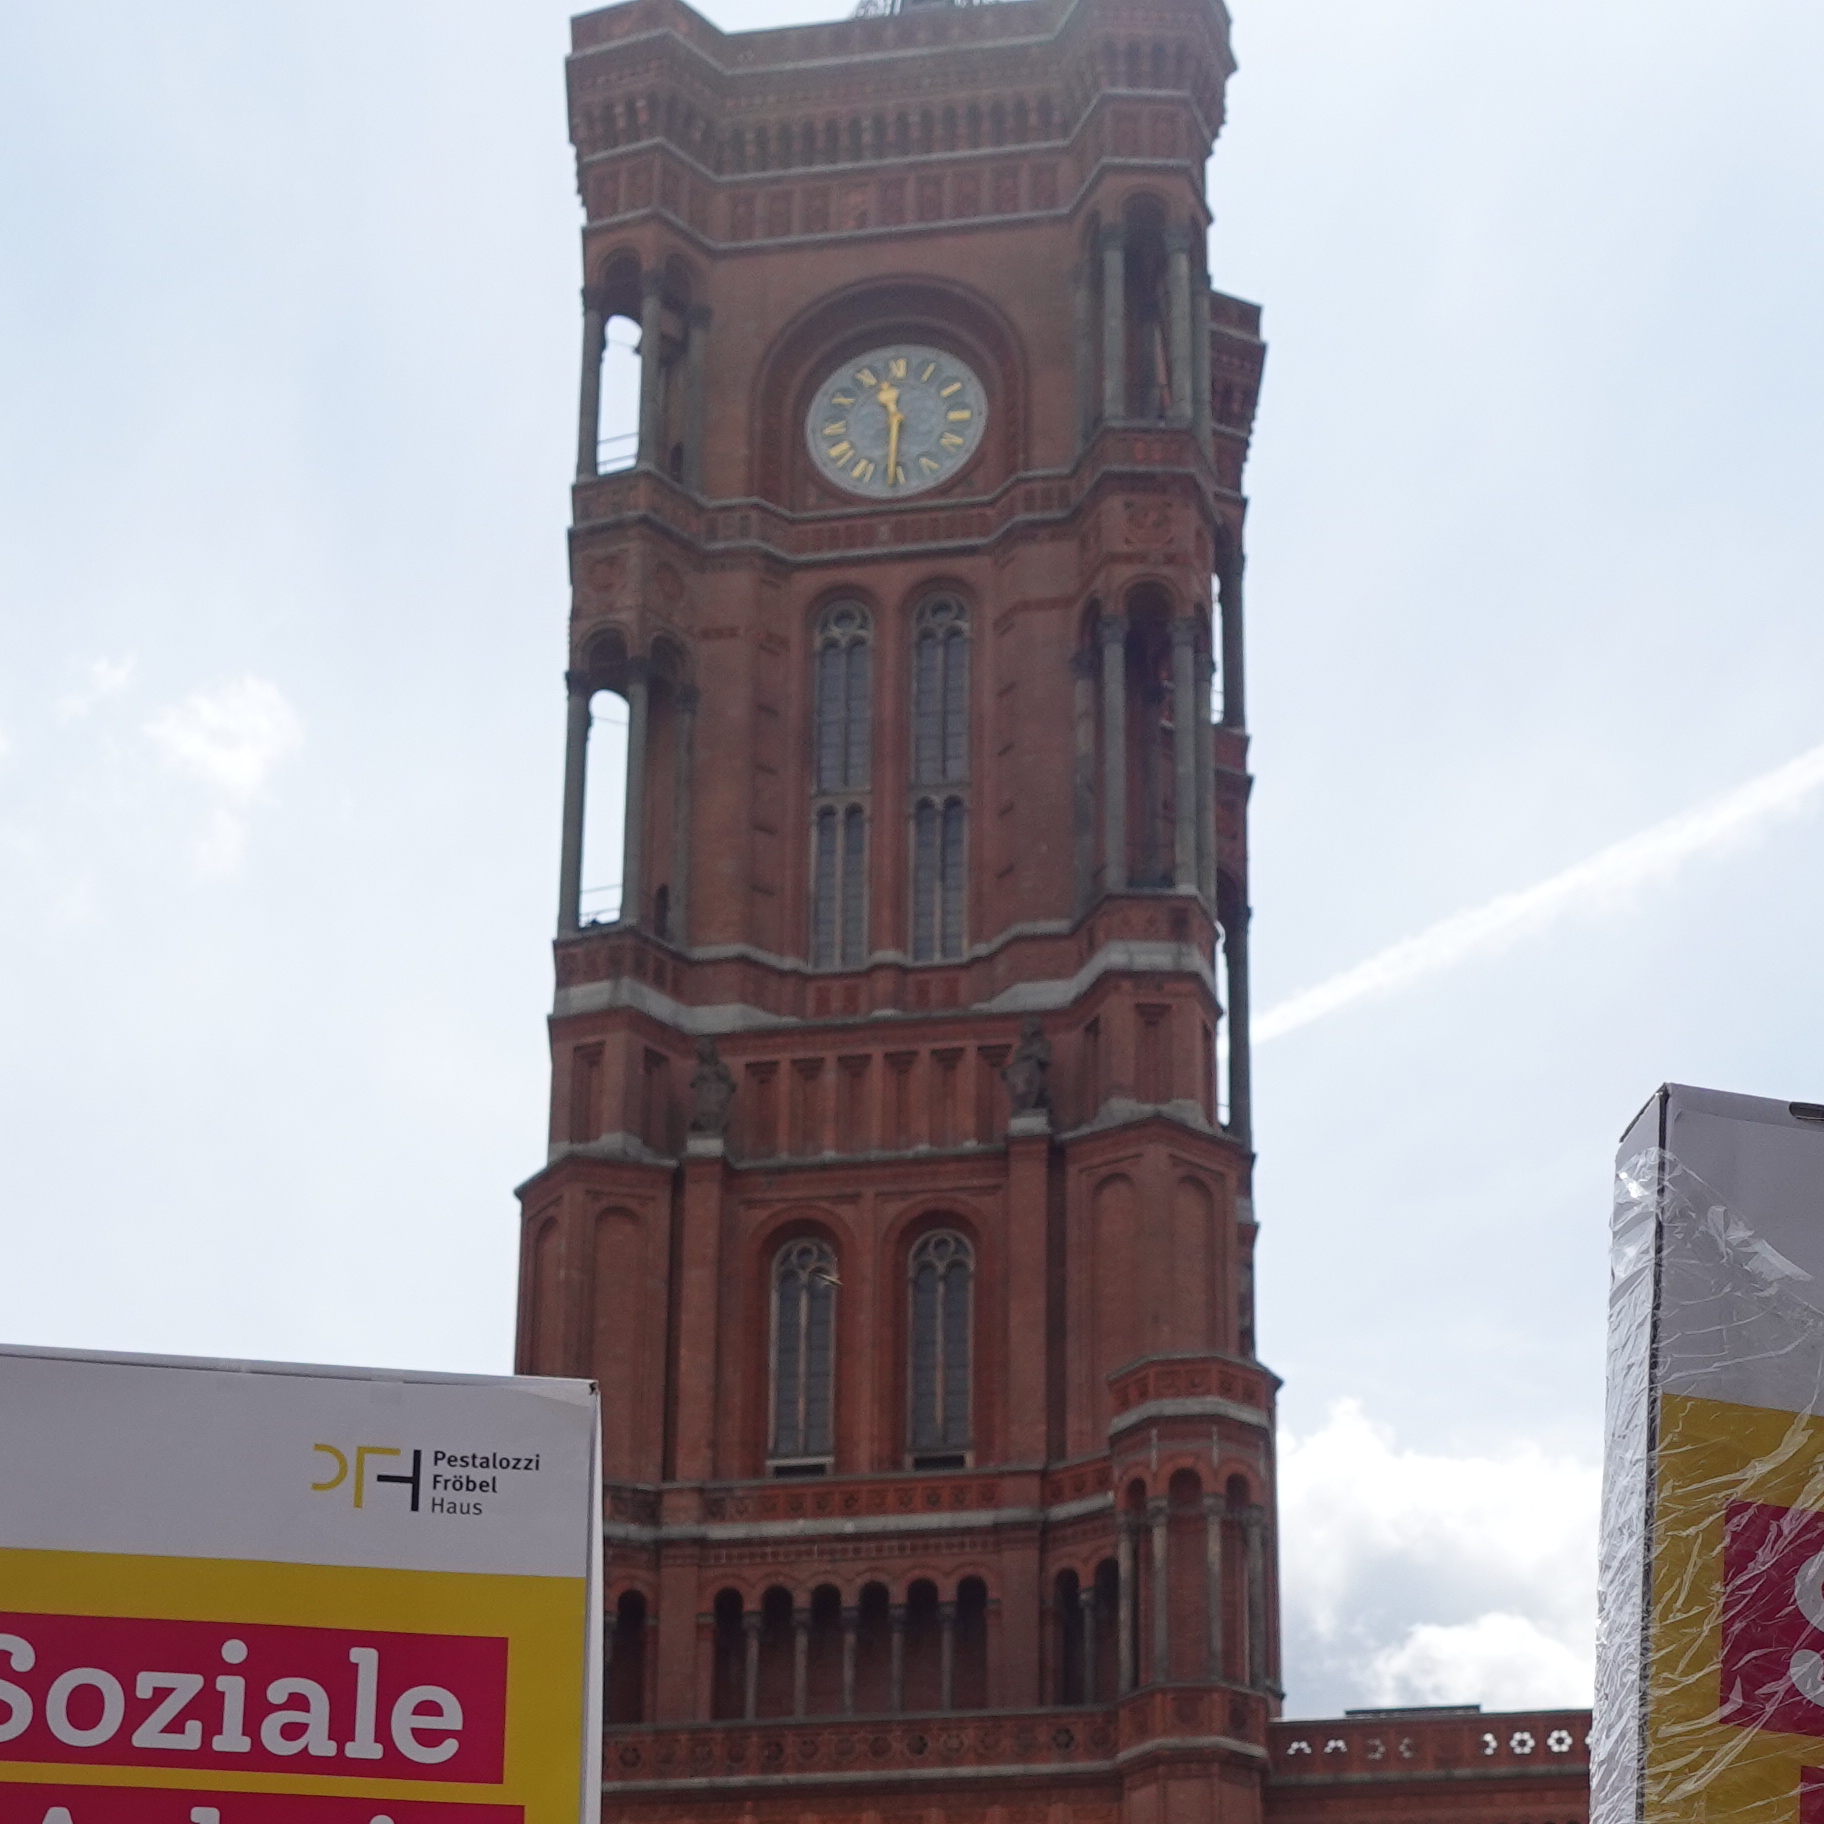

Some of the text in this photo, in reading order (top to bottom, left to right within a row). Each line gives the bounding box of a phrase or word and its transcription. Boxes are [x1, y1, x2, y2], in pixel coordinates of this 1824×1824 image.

[433, 1450, 541, 1471] Pestalozzi
[432, 1474, 498, 1493] Fröbel
[431, 1497, 483, 1515] Haus
